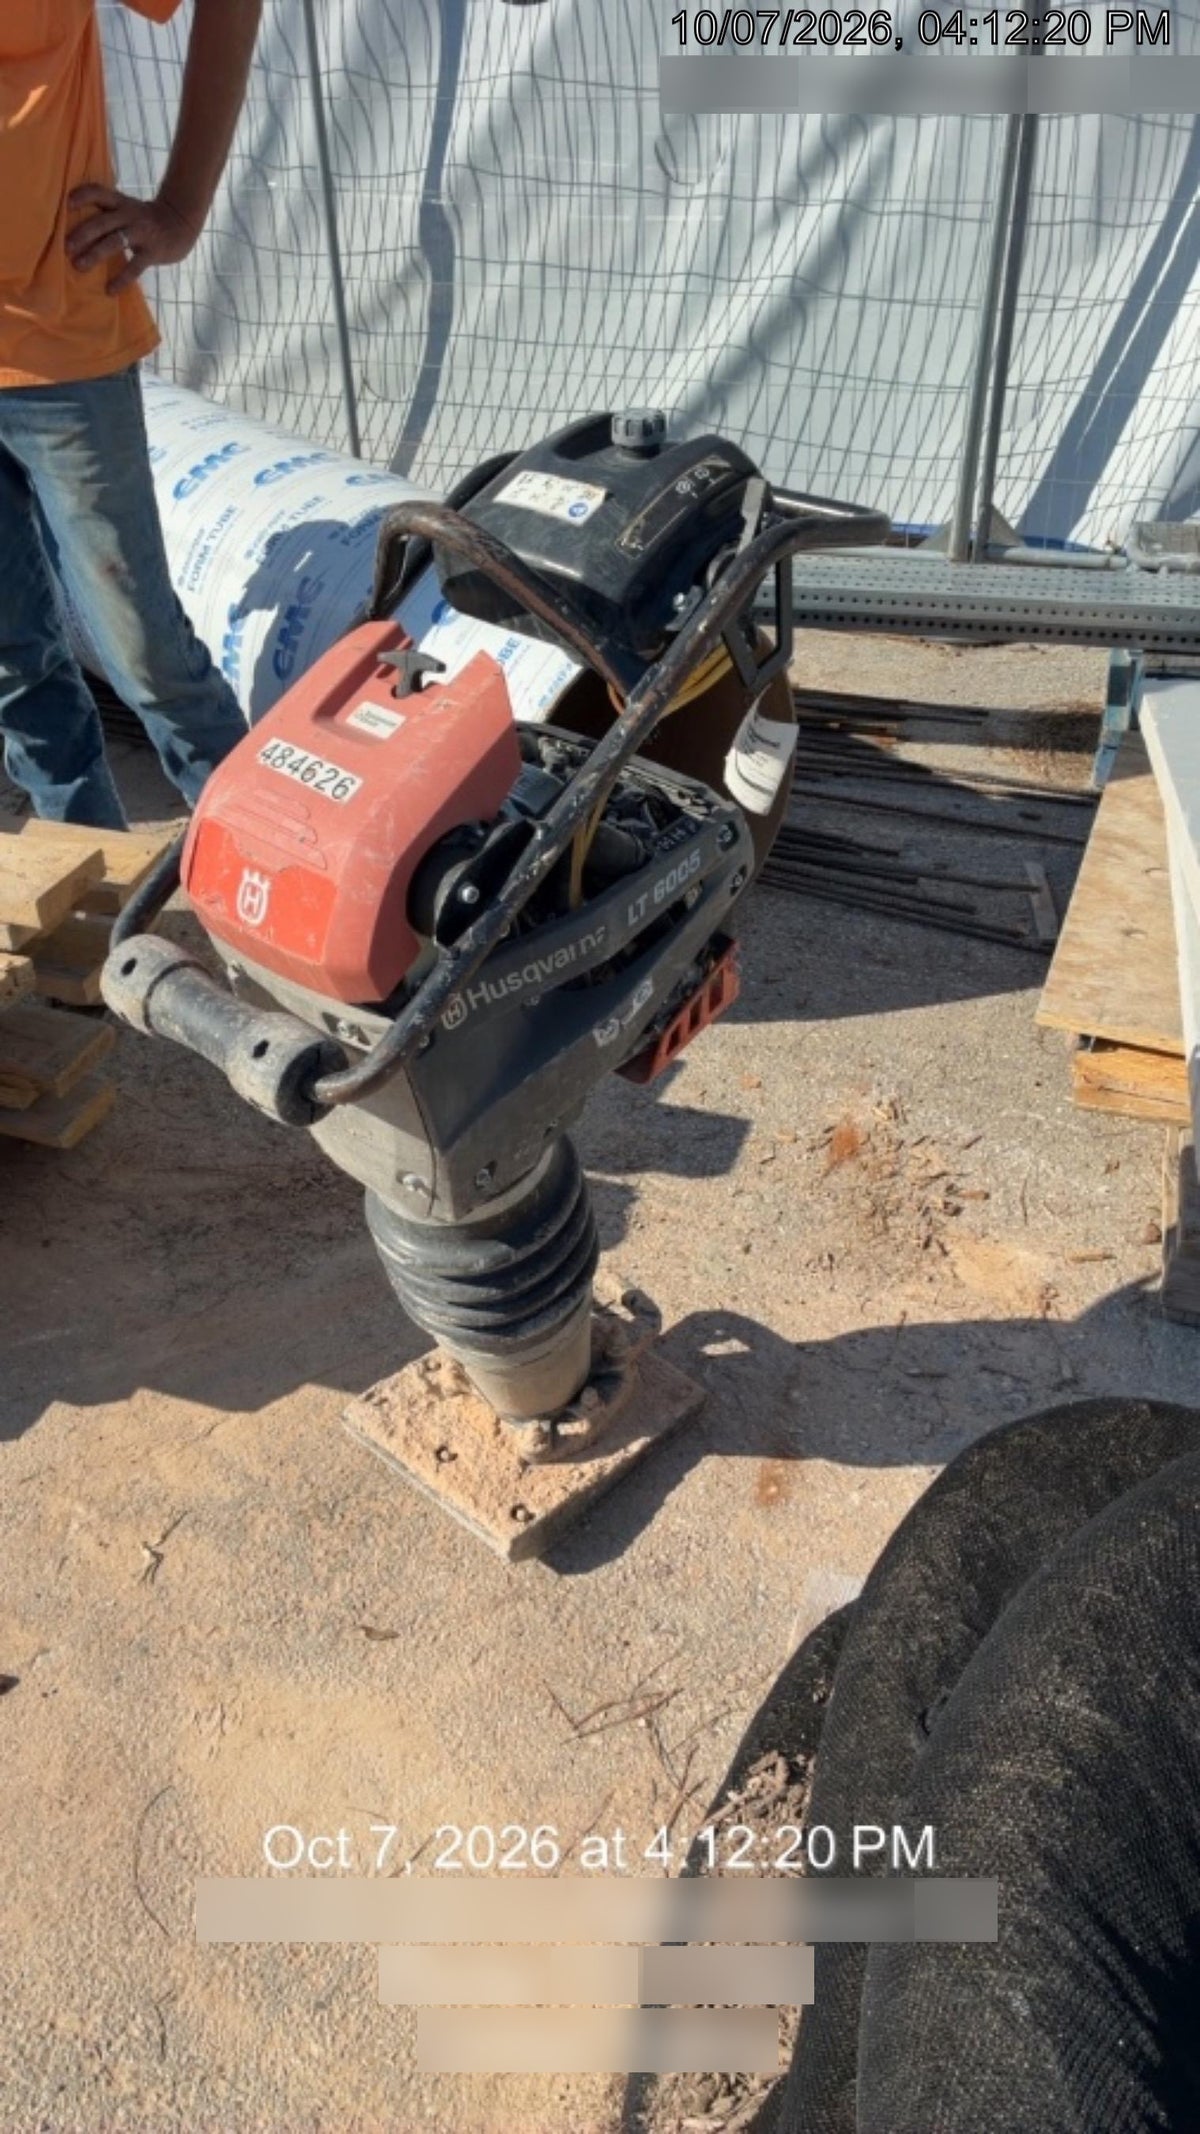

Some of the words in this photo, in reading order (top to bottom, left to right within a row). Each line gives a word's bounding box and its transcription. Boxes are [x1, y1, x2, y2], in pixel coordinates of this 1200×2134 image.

[261, 743, 355, 800] 484626
[628, 892, 648, 927] LT
[654, 848, 701, 904] 6005
